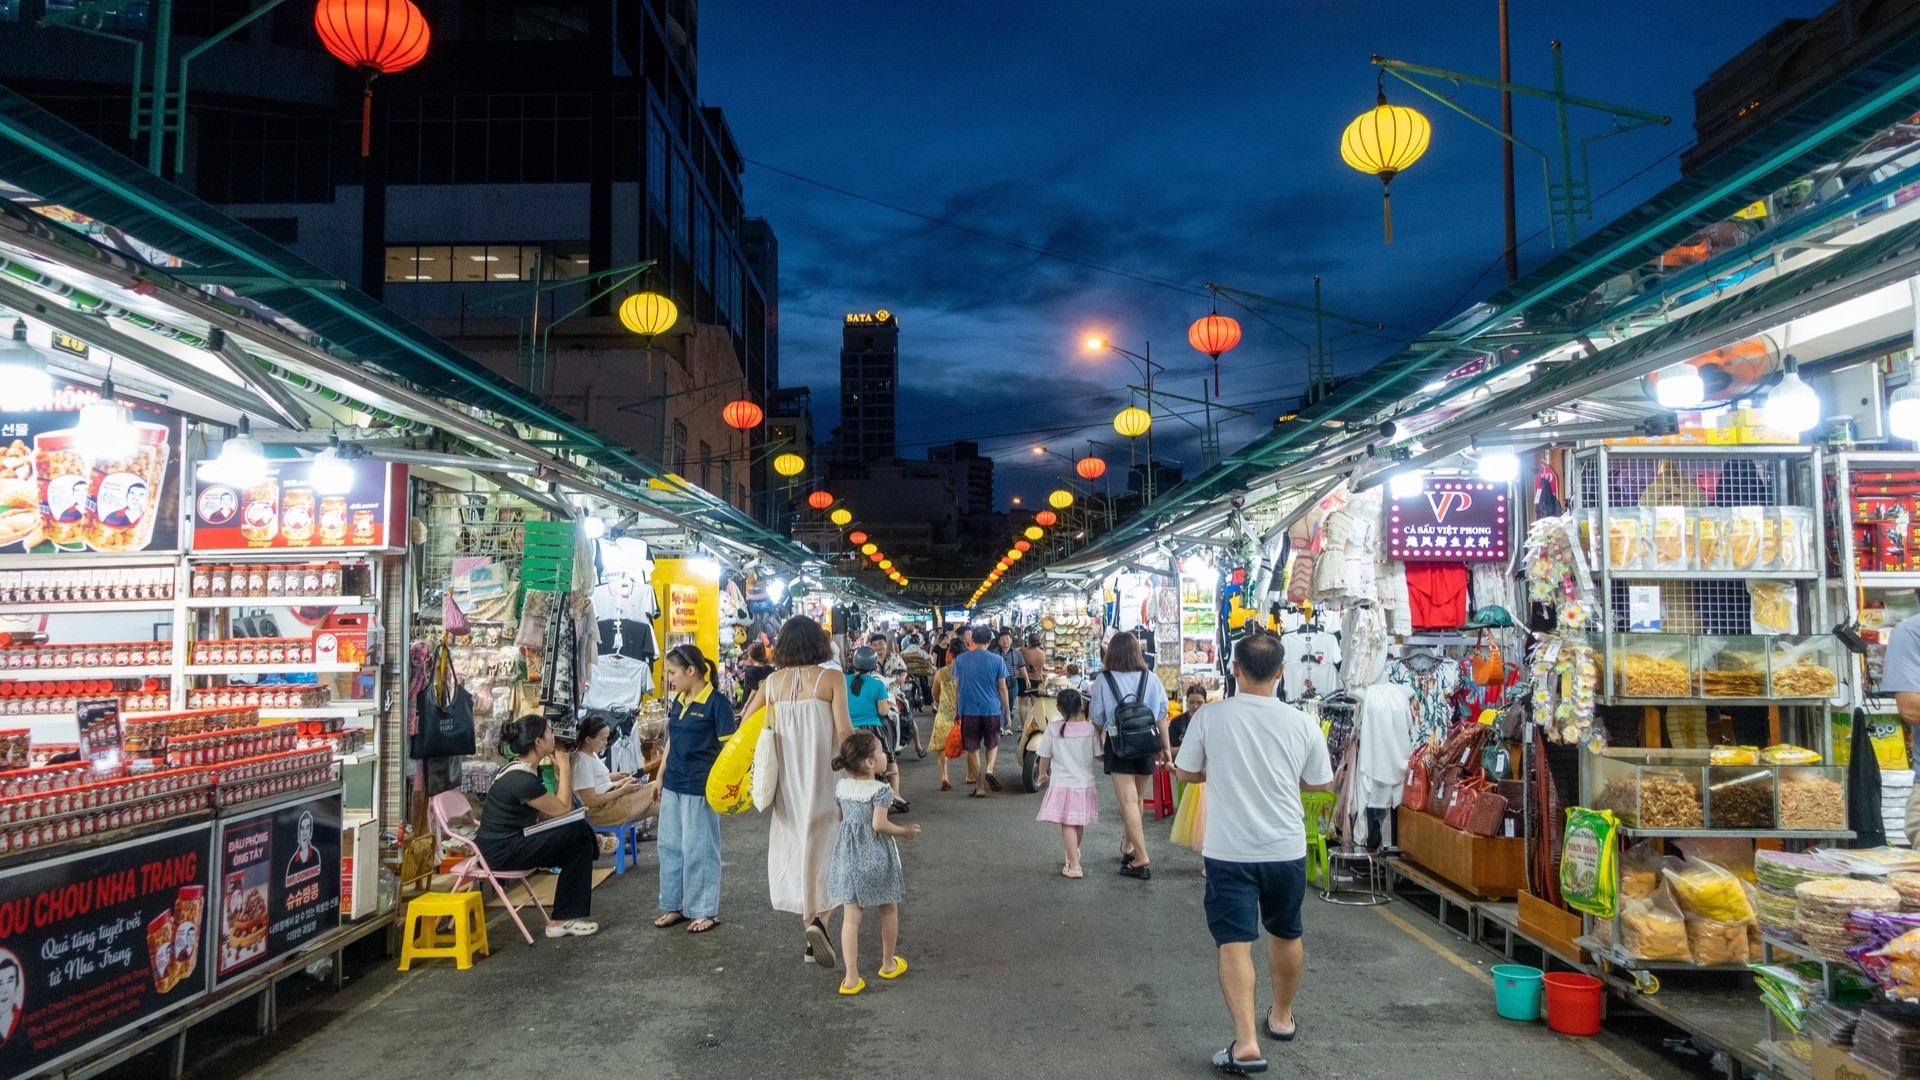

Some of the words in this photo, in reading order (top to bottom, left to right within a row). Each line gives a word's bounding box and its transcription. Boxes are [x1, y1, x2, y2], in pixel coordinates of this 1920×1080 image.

[846, 313, 872, 322] SATA
[1, 423, 29, 437] 선물
[1424, 491, 1472, 523] VP
[1403, 524, 1416, 534] CÁ
[1417, 523, 1435, 534] SẤU
[1437, 524, 1458, 536] VIỆT
[1459, 526, 1492, 535] PHONG
[352, 537, 375, 545] 100gr
[34, 879, 93, 928] CHOU
[95, 868, 136, 909] NHA
[140, 852, 197, 895] TRANG
[286, 883, 319, 911] 슈슈땅콩
[71, 931, 97, 951] tặng
[64, 956, 95, 981] Nha
[97, 946, 132, 968] Trang
